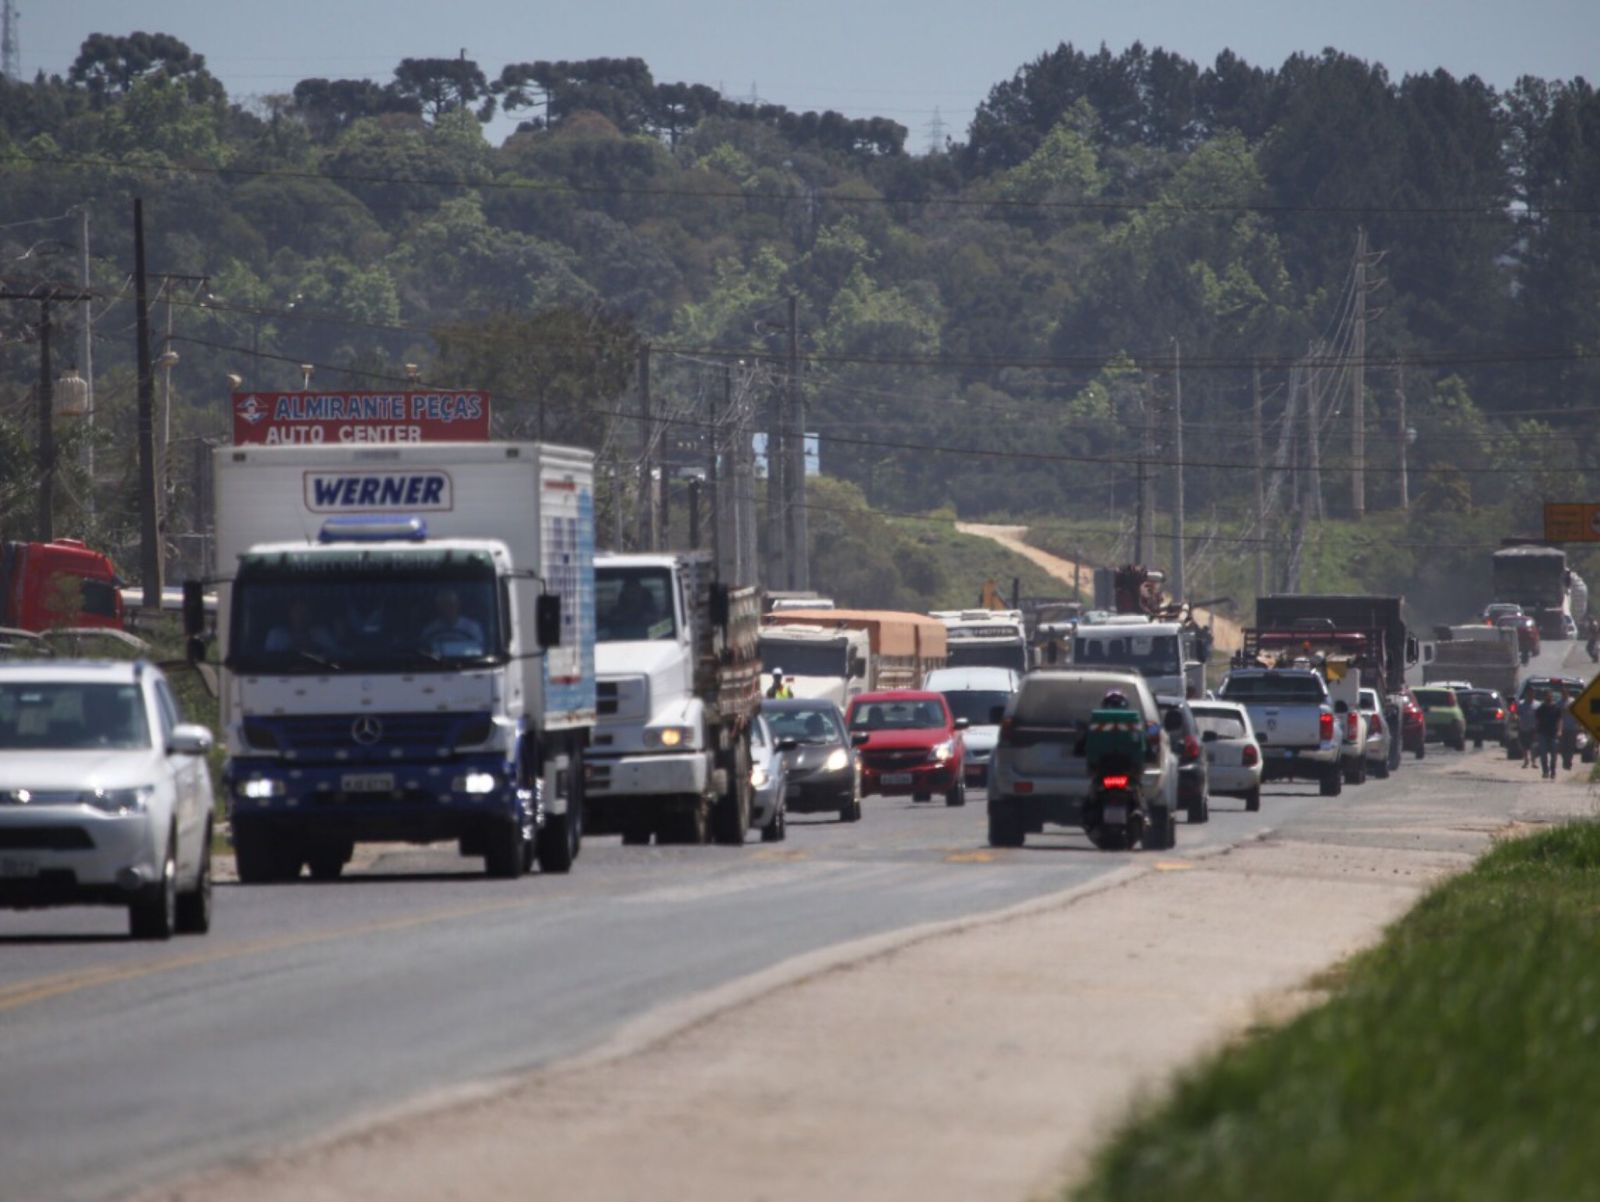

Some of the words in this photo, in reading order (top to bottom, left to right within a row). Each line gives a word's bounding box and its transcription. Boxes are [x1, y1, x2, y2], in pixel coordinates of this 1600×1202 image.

[273, 395, 406, 421] ALMIRANTE
[411, 394, 483, 422] PEÇAS
[265, 425, 325, 445] AUTO
[338, 425, 422, 444] CENTER
[313, 475, 445, 506] WERNER
